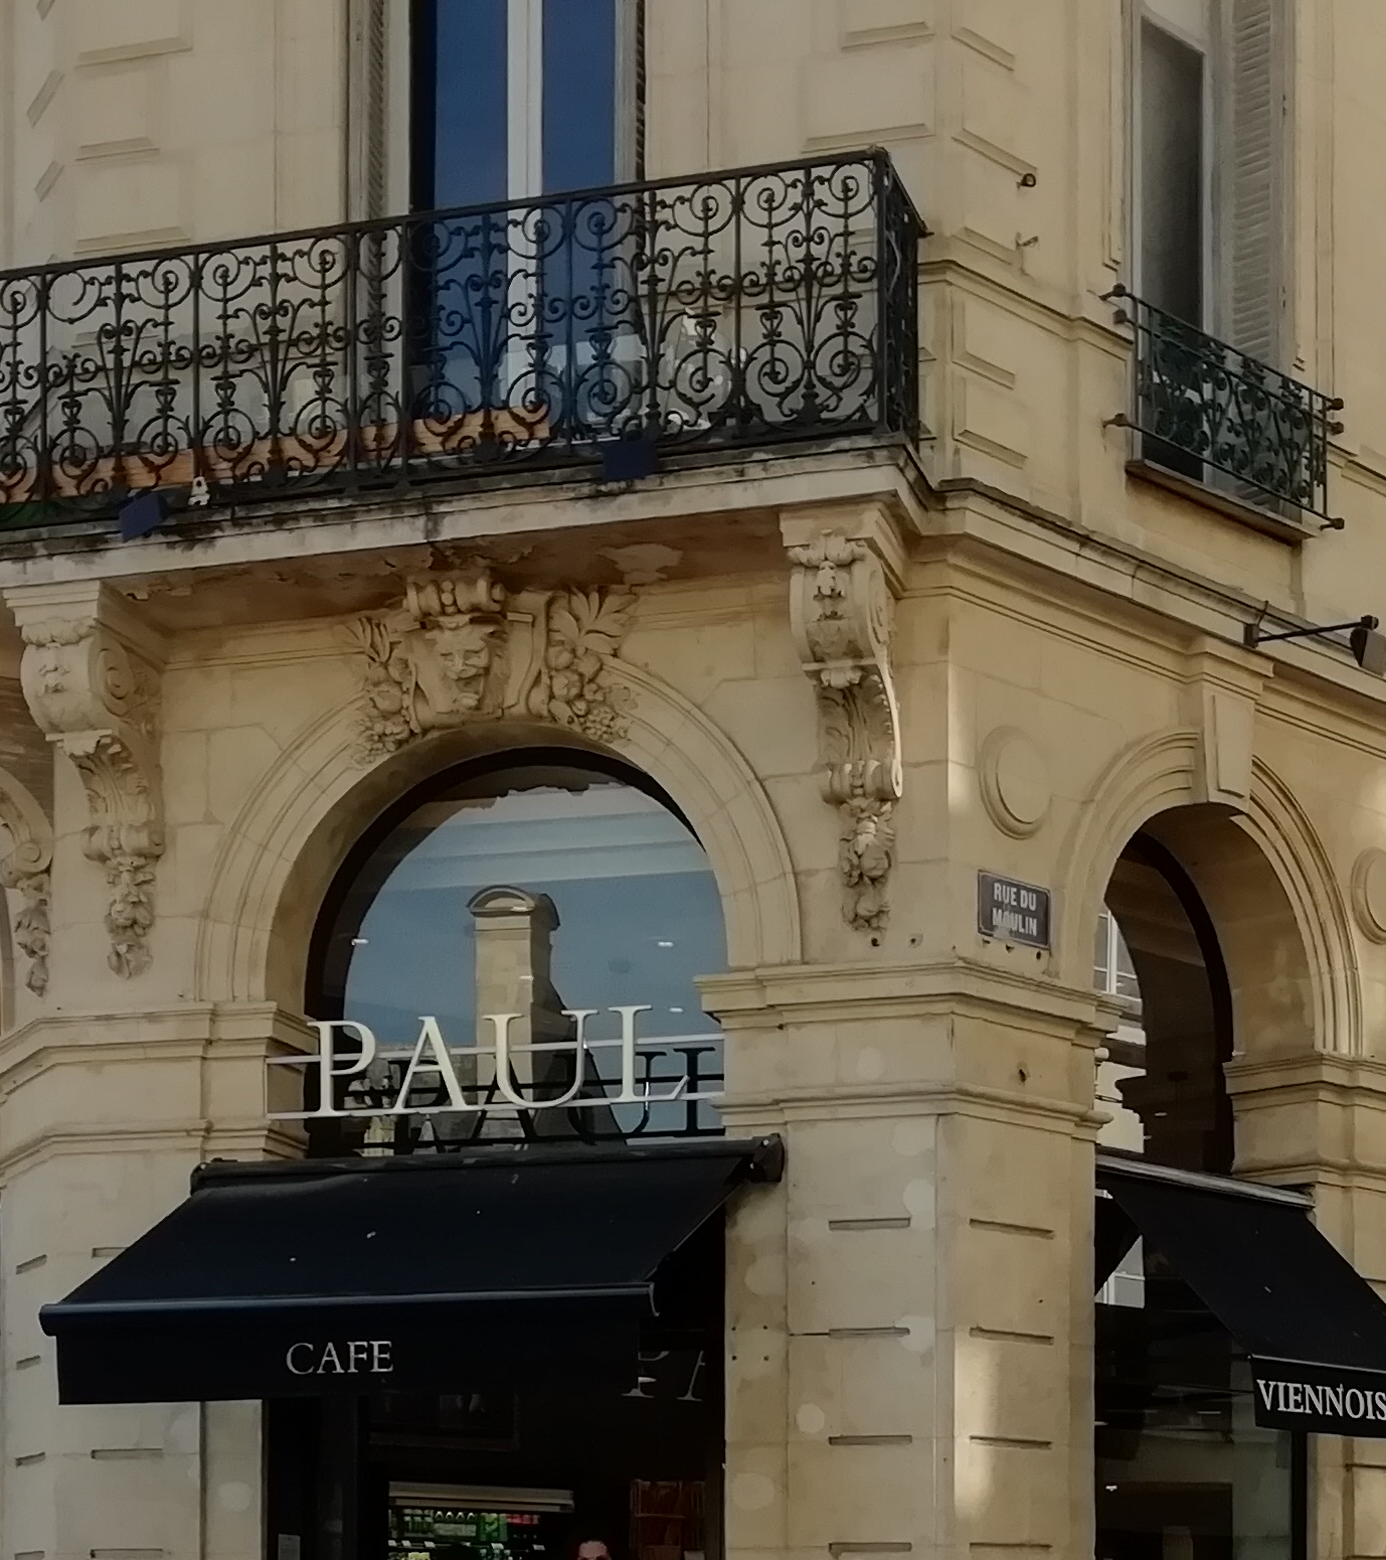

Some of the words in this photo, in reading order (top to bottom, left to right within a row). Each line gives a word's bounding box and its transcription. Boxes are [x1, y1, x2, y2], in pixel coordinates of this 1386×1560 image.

[994, 882, 1017, 906] RUE
[1020, 889, 1037, 911] DU
[307, 1005, 690, 1117] PAUL
[286, 1341, 393, 1375] CAFE
